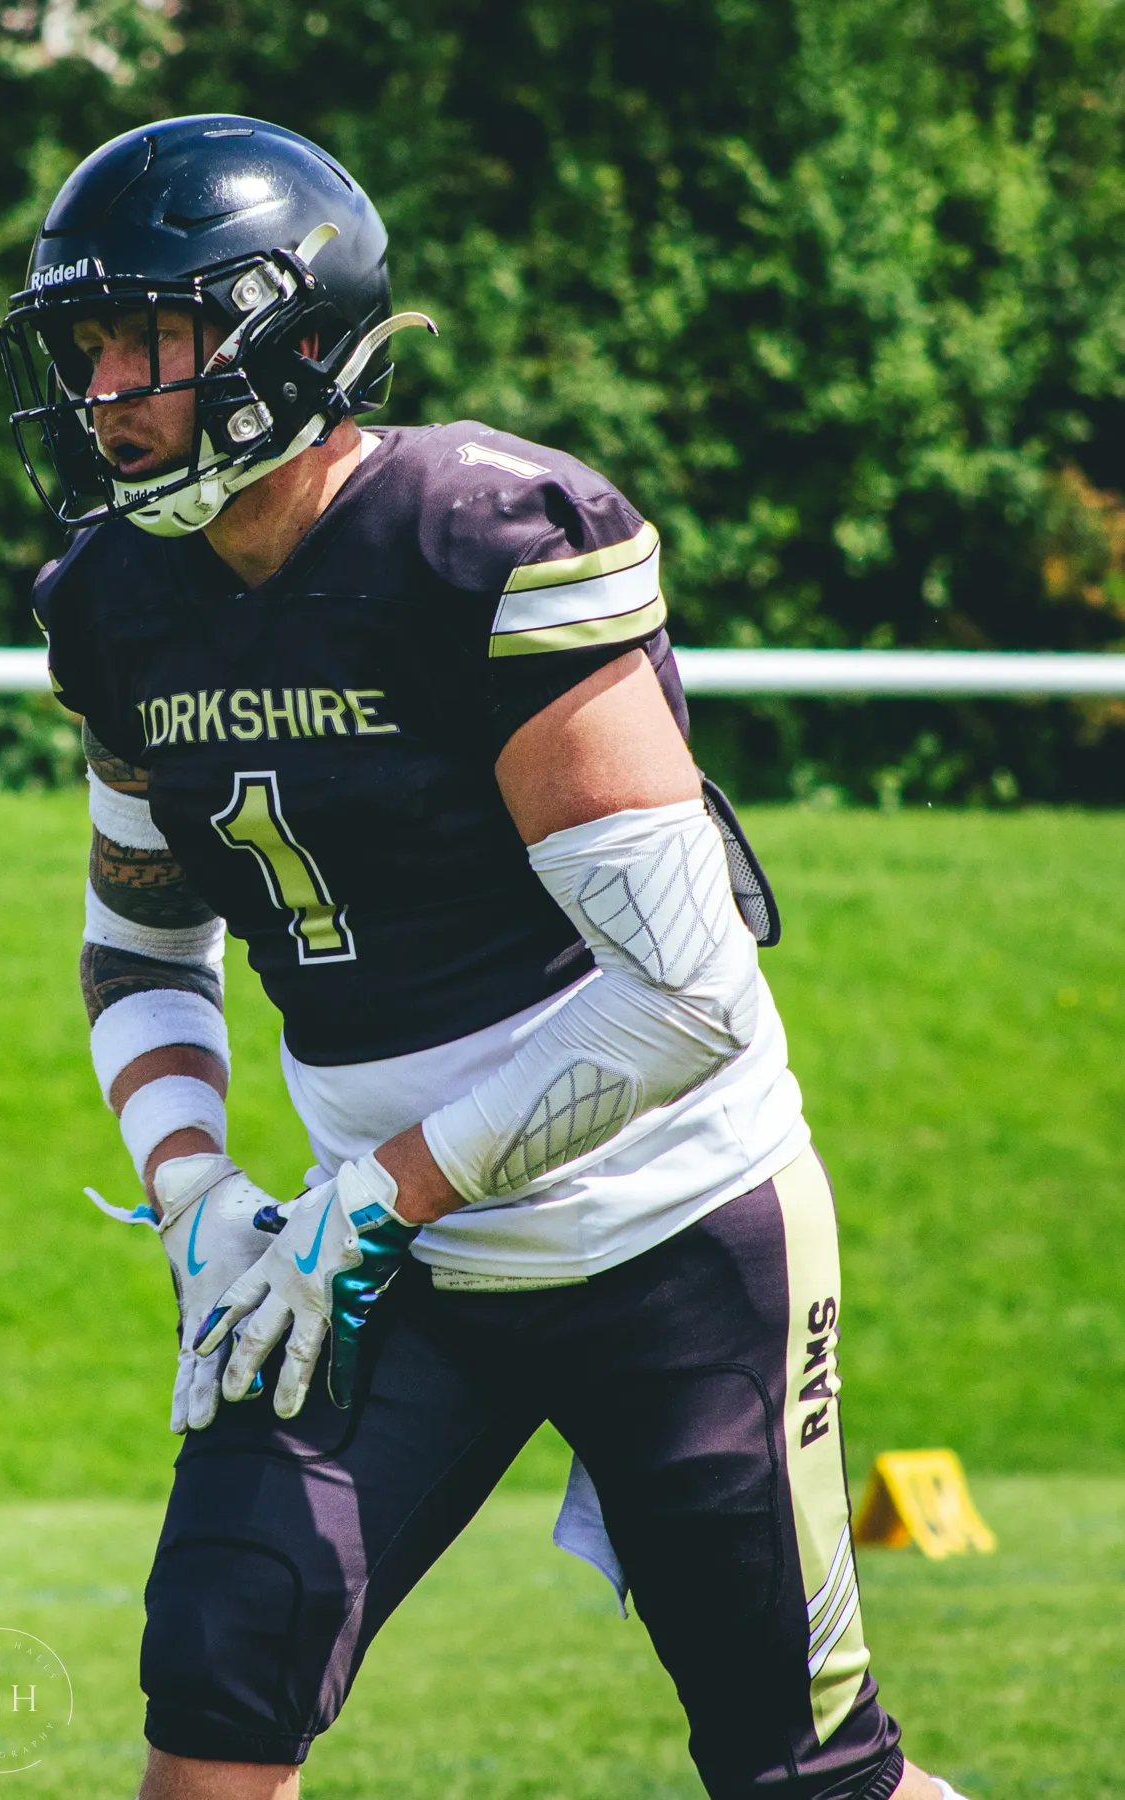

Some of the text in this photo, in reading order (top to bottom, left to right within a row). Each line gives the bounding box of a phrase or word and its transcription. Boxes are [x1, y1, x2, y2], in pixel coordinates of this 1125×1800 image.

[31, 258, 89, 289] Riddell
[456, 441, 552, 480] 1
[210, 770, 357, 965] 1
[799, 1296, 836, 1449] RAMS
